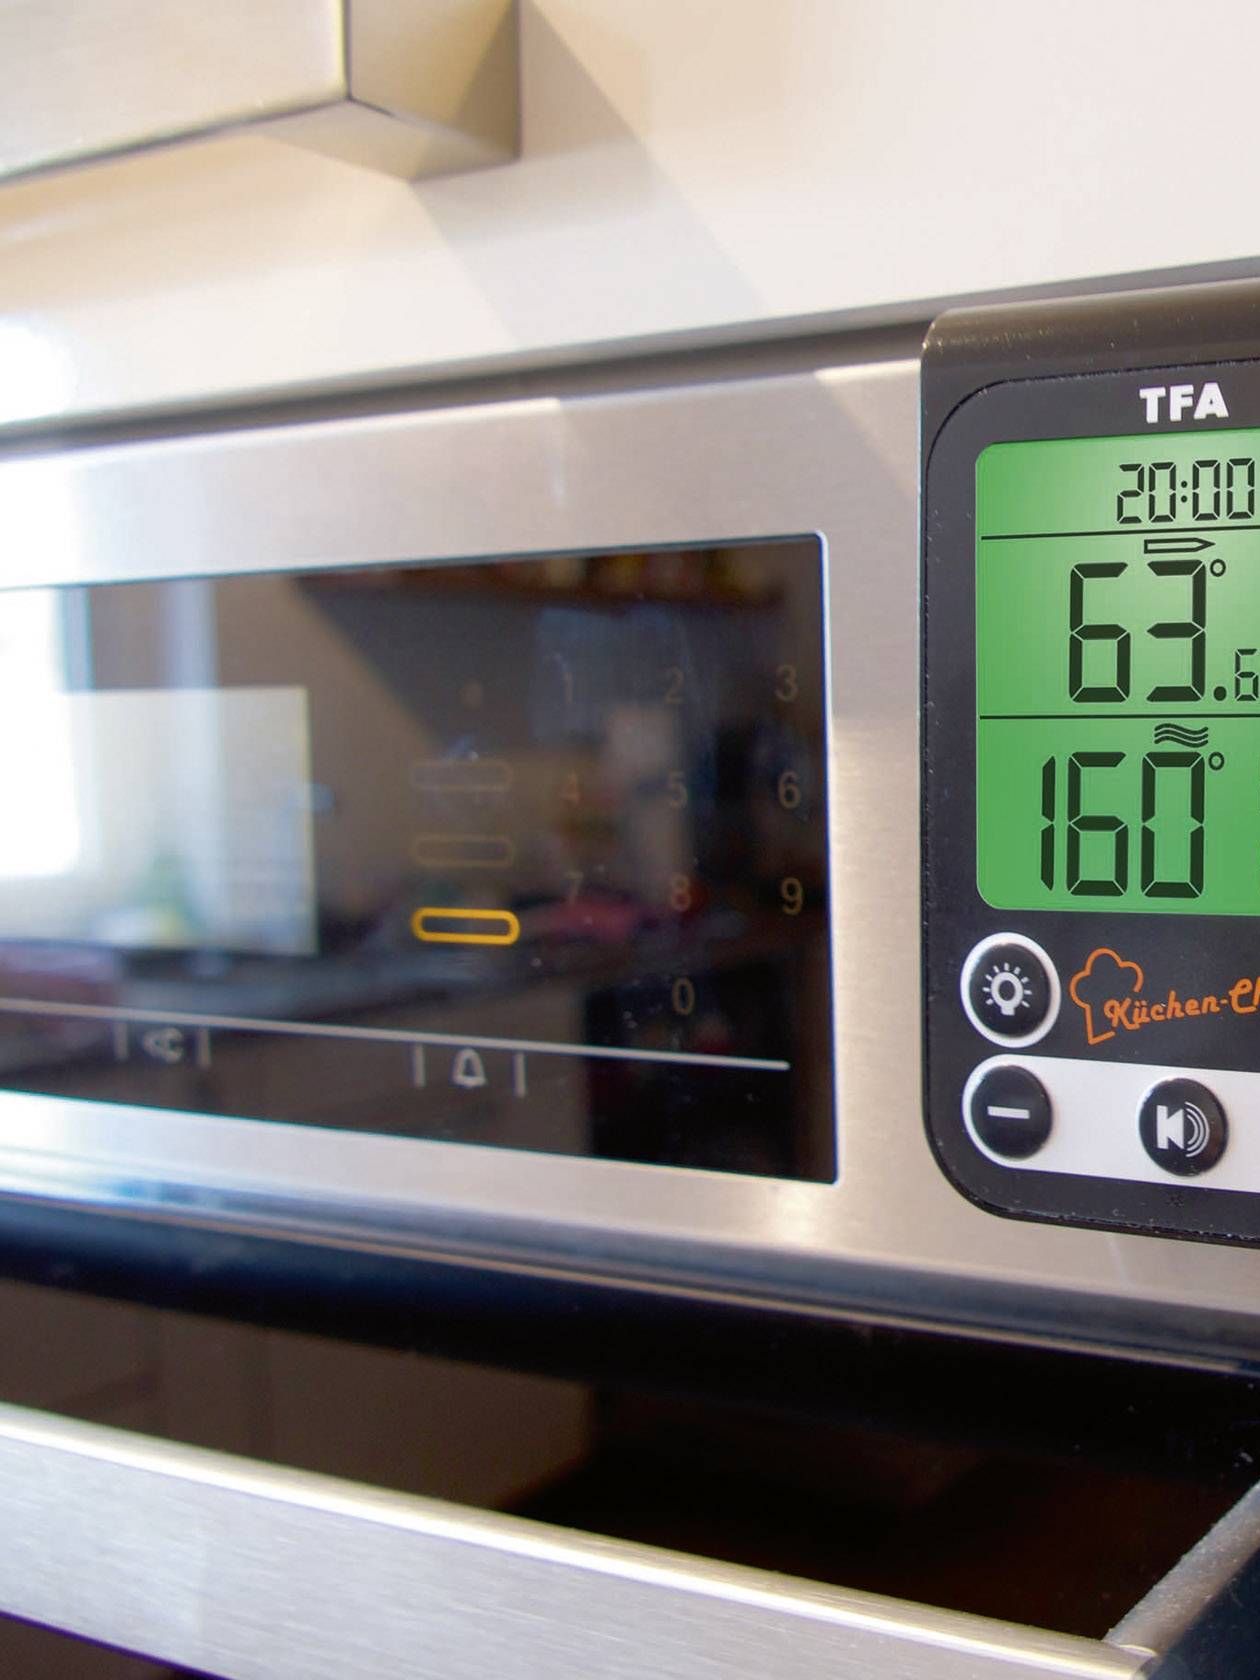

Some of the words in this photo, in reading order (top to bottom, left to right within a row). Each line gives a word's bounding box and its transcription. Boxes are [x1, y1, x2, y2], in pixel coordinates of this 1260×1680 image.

[1139, 382, 1230, 424] TFA
[1116, 457, 1256, 524] 20:00
[775, 664, 799, 702] 3
[777, 770, 800, 809] 6
[670, 874, 692, 912] 8
[779, 877, 803, 916] 9
